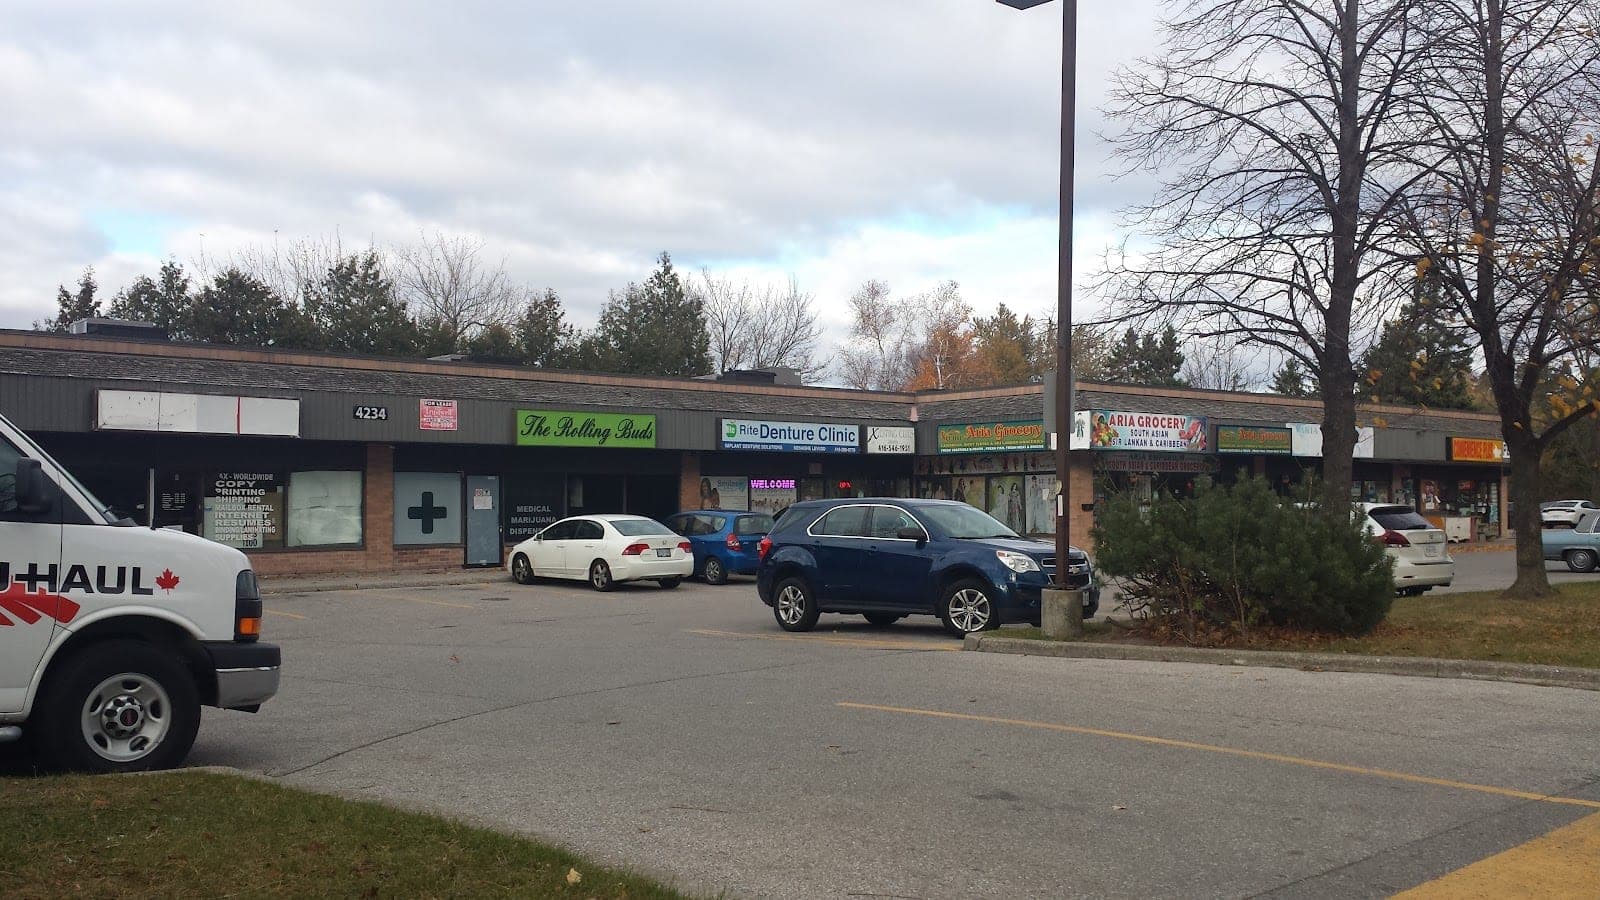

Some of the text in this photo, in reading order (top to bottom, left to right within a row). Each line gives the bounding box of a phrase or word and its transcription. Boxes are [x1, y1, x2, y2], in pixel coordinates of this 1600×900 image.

[356, 407, 386, 419] 4234
[1110, 414, 1186, 429] ARIA GROCERY
[521, 414, 653, 445] The Rolling Buds
[740, 424, 856, 442] Rite Denture Clinic
[1151, 430, 1169, 438] ASIAN
[1125, 439, 1148, 447] LANKAN
[1155, 440, 1188, 448] CARIBBEAN
[750, 479, 796, 489] WELCOME
[215, 488, 266, 496] PRINTING
[215, 496, 261, 504] SHIPPING
[247, 504, 274, 512] RENTAL
[215, 511, 269, 519] INTERNET
[215, 519, 272, 527] RESUMES
[511, 516, 557, 524] MARIJUANA
